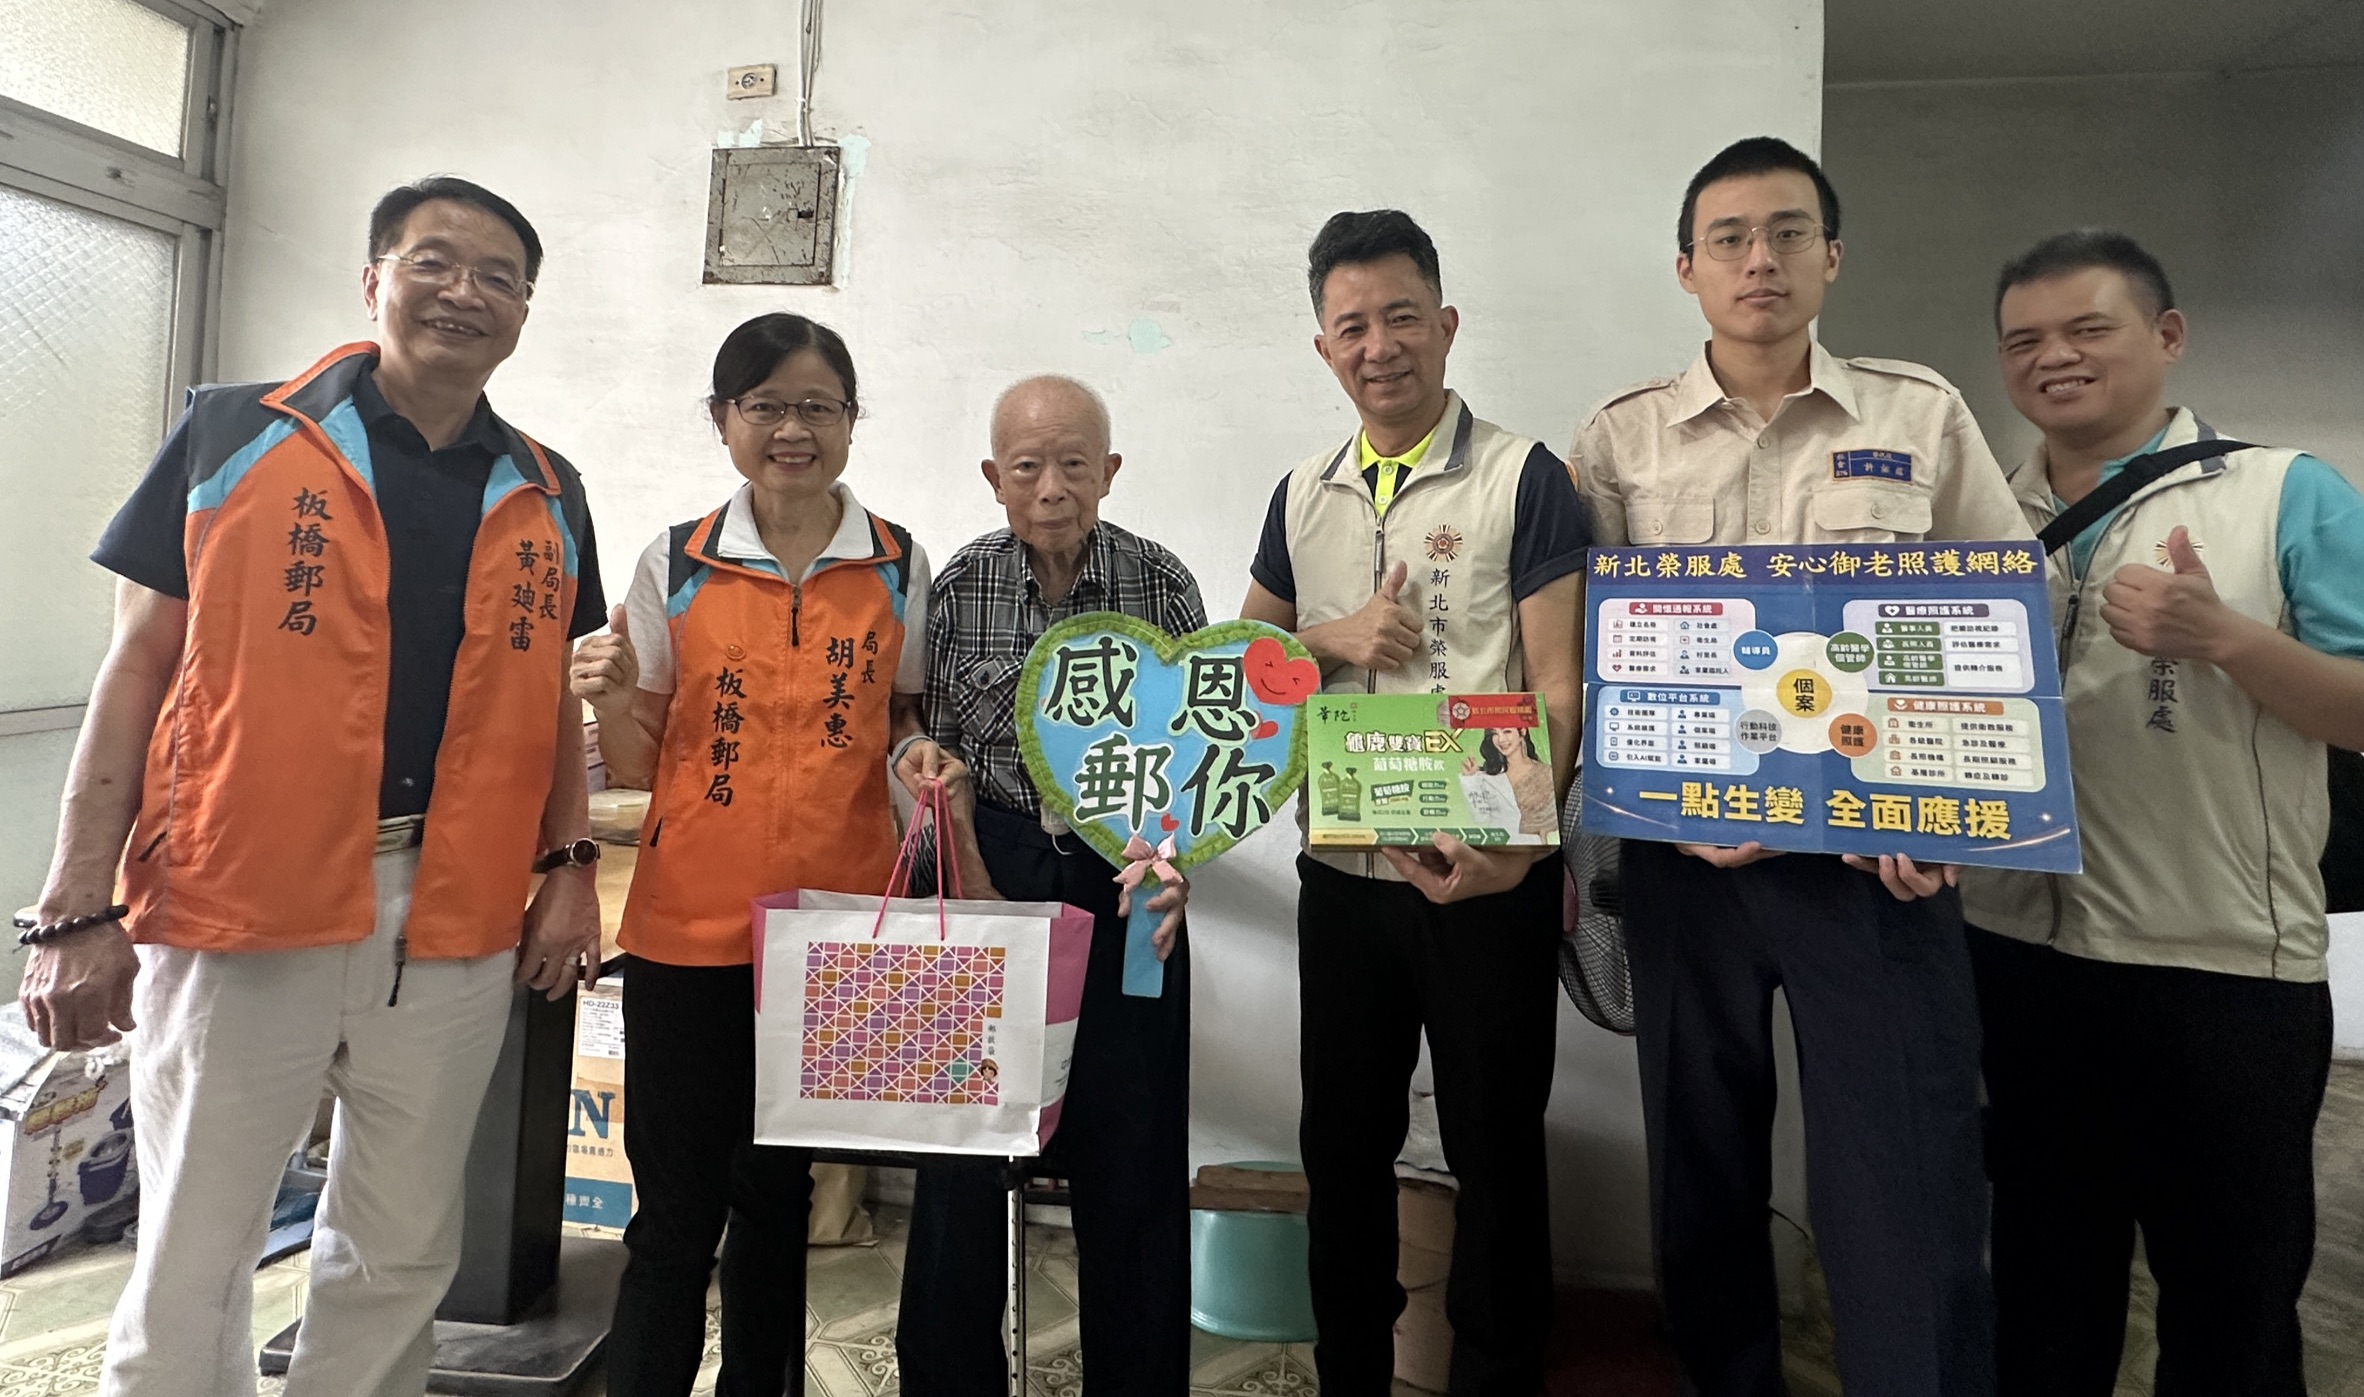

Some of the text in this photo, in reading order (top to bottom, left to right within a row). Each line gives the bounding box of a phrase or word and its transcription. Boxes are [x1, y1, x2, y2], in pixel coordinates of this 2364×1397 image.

[278, 487, 333, 636] 板橋郵局
[539, 540, 561, 620] 副局長
[1593, 549, 2039, 578] 新北榮服處 安心御老照護網絡
[1905, 605, 1975, 616] 醫療照護系統
[860, 630, 878, 684] 局長
[1741, 646, 1771, 655] 輔導員
[820, 636, 855, 748] 胡美惠
[1045, 636, 1258, 741] 感恩
[1793, 678, 1815, 712] 個案
[1912, 700, 1987, 713] 健康照護系統
[704, 667, 747, 807] 板橋郵局
[1840, 724, 1864, 735] 健康
[1073, 733, 1276, 838] 郵你
[1638, 781, 2013, 841] 一點生變 全面應援
